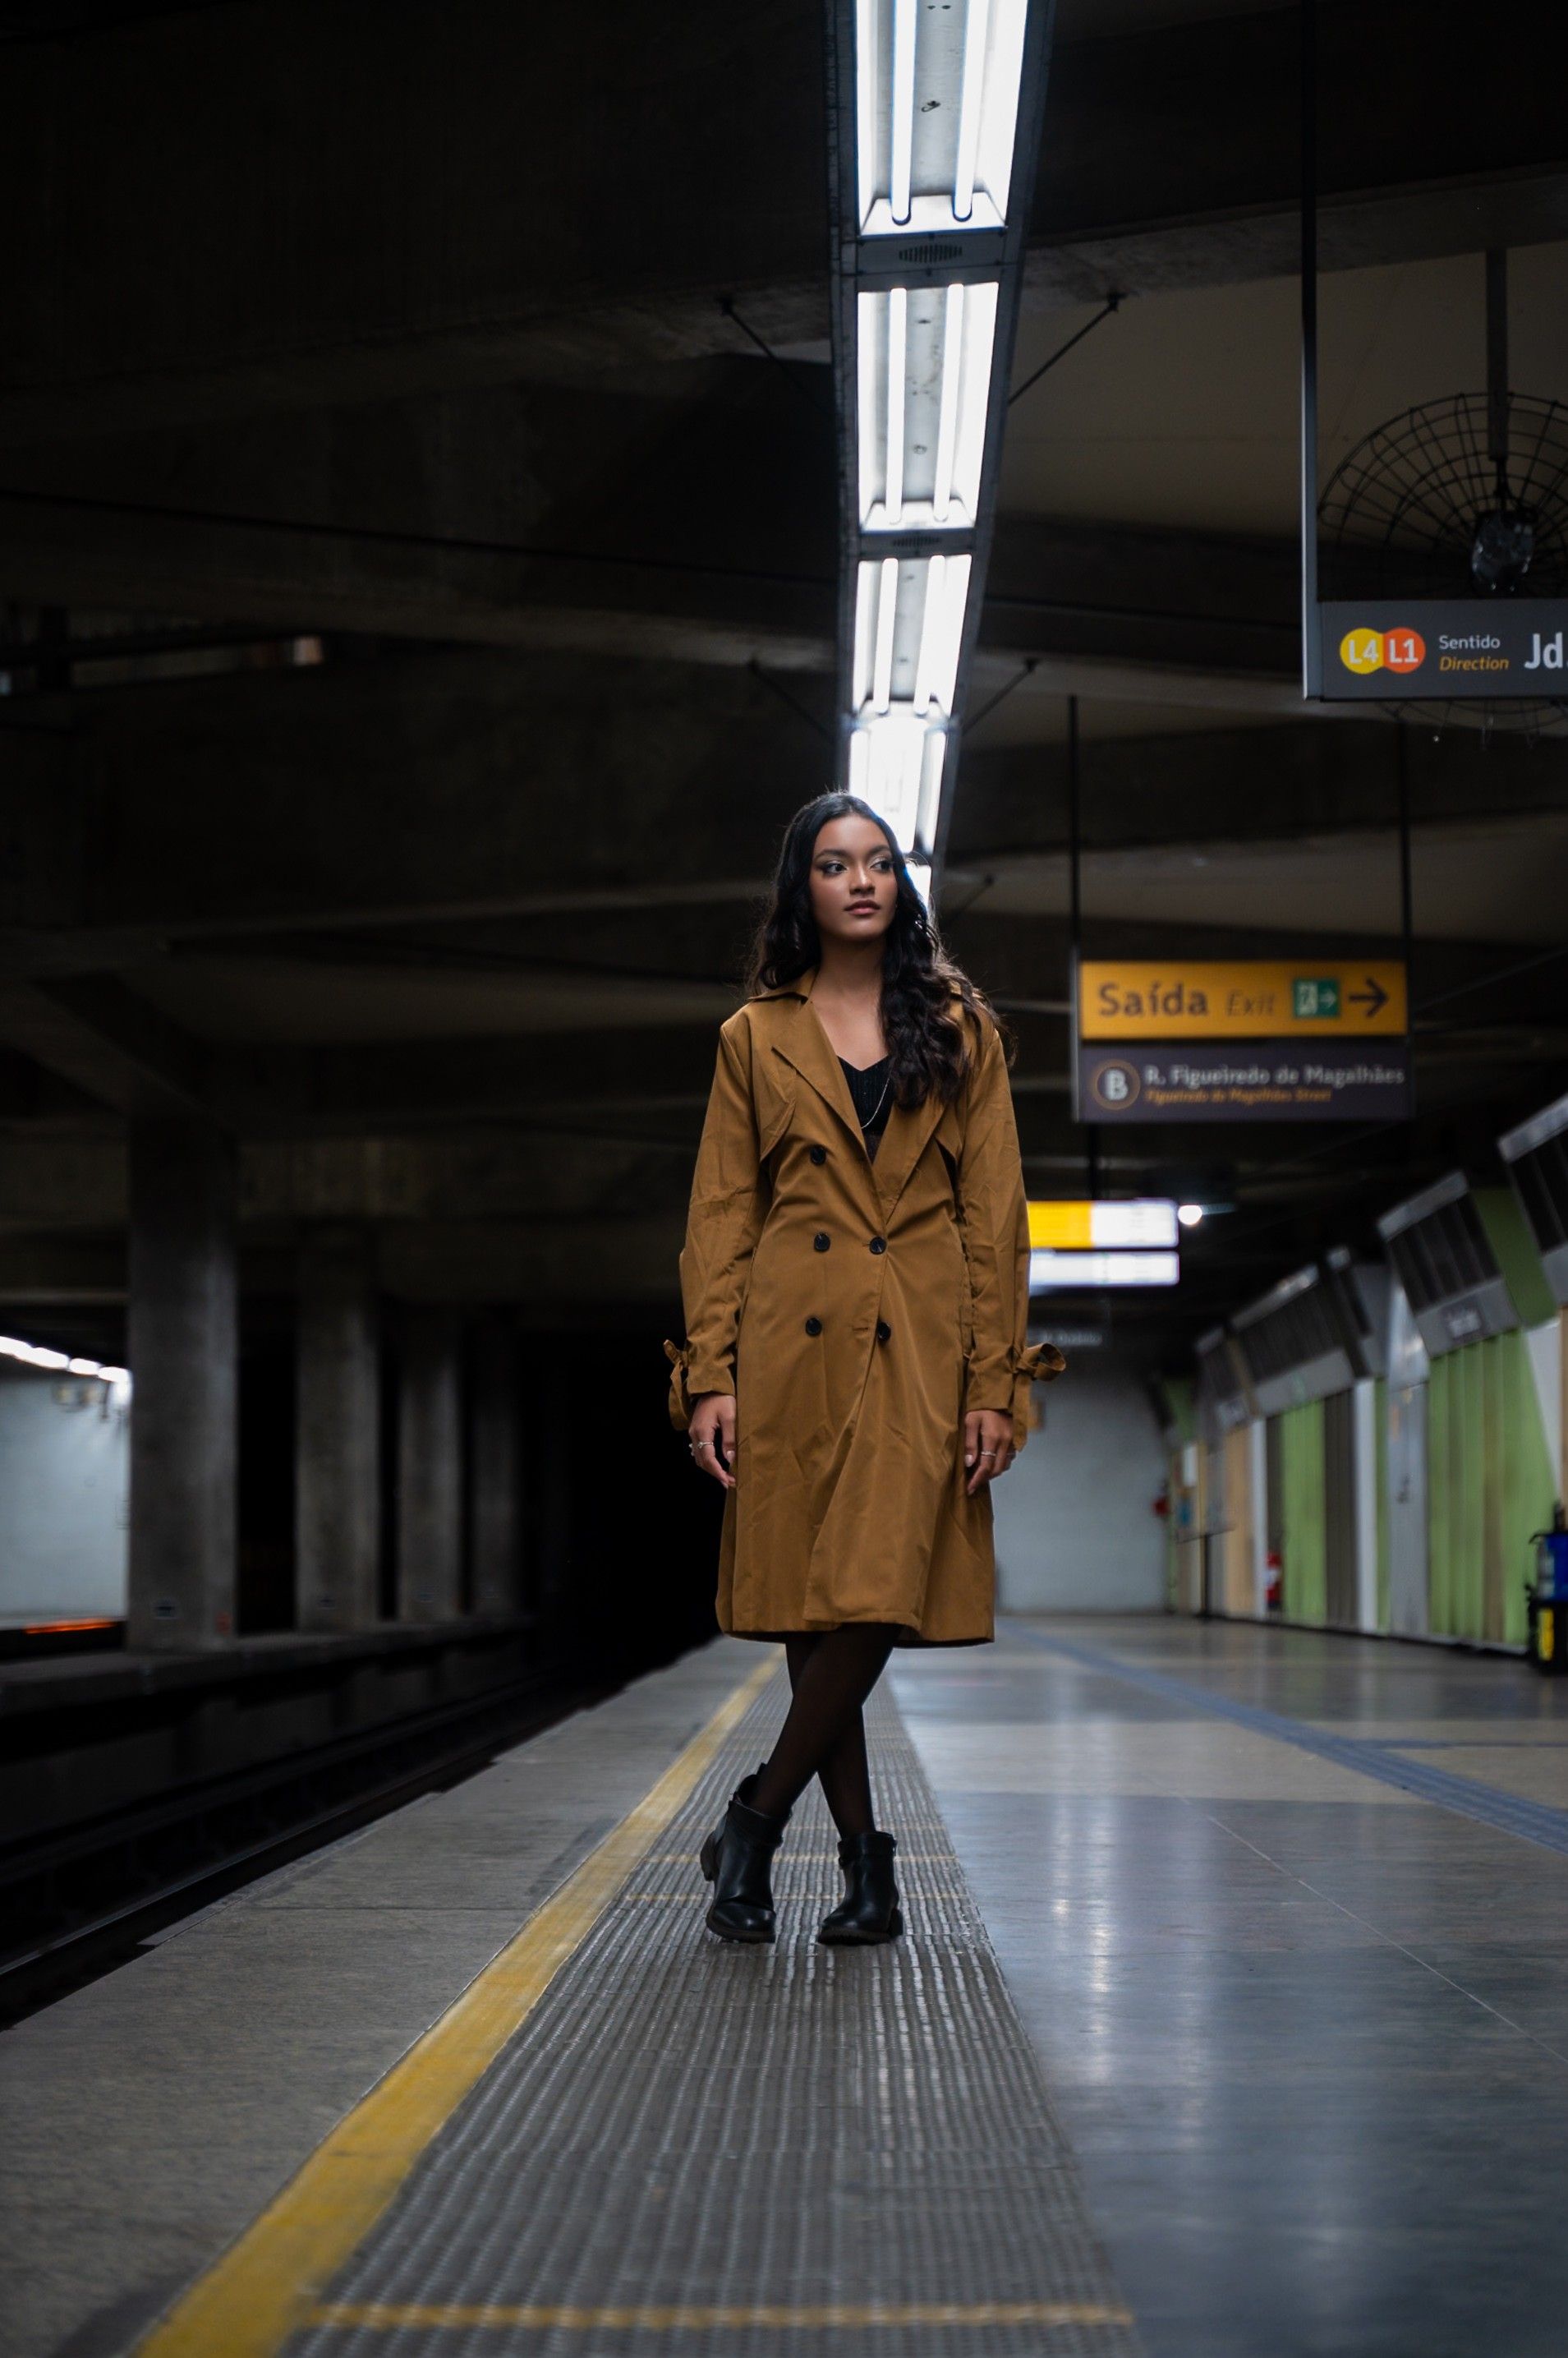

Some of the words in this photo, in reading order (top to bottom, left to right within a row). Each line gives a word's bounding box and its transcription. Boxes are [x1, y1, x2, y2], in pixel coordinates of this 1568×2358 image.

[1348, 638, 1380, 665] L4
[1388, 638, 1419, 664] L1
[1438, 635, 1501, 651] Sentido
[1523, 632, 1568, 670] Jd
[1438, 656, 1510, 672] Direction
[1098, 981, 1208, 1016] Saída
[1105, 1068, 1129, 1102] B
[1275, 1064, 1300, 1085] de
